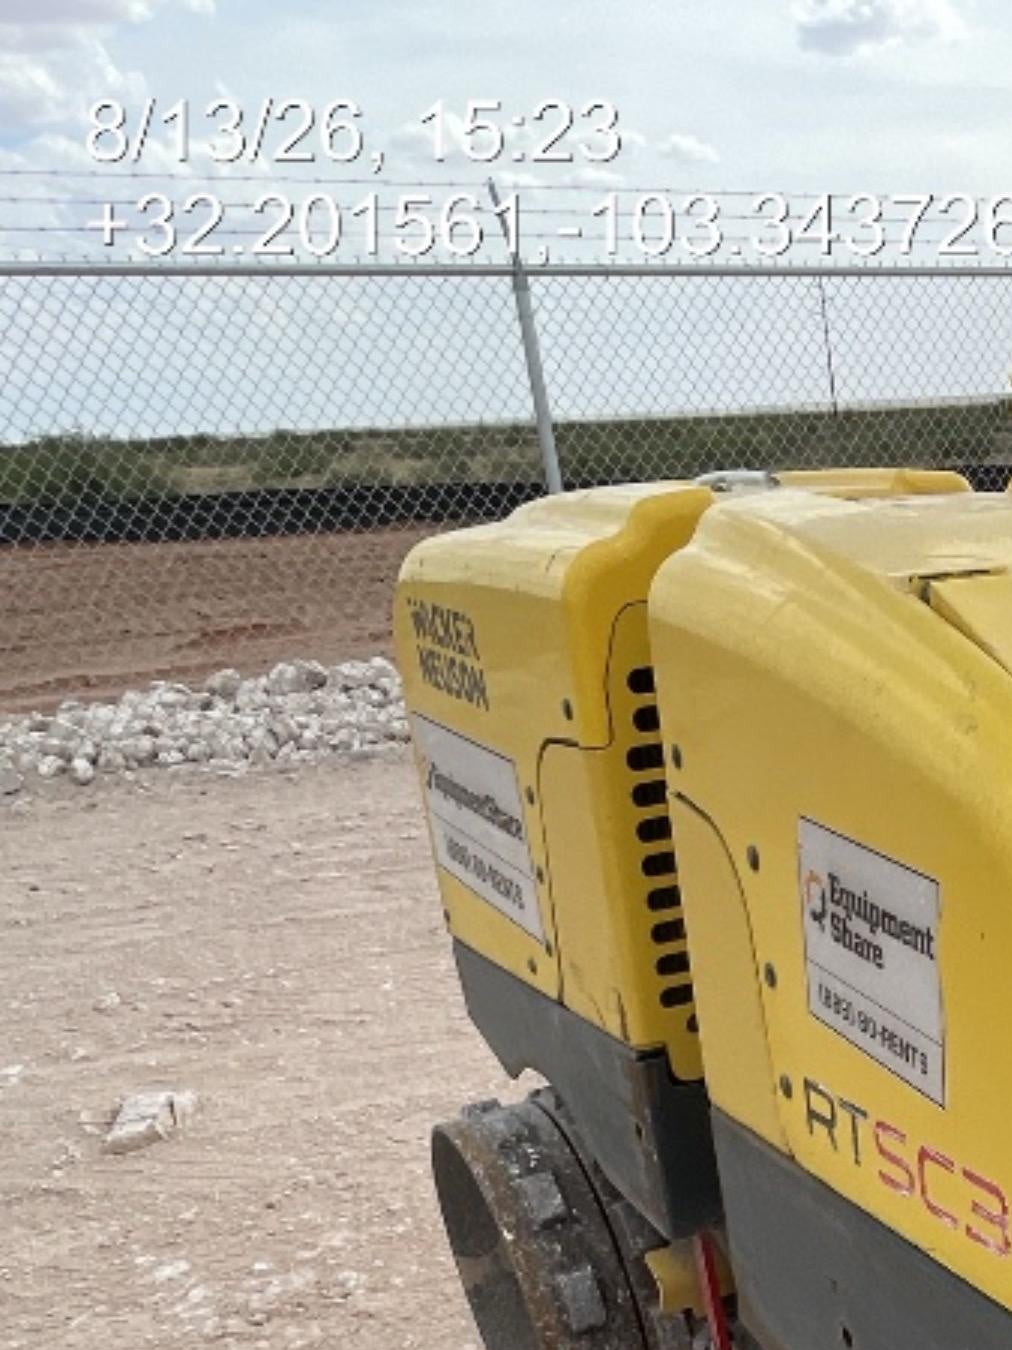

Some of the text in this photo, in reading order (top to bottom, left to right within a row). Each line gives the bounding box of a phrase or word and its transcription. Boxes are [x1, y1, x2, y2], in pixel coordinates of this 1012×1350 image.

[827, 872, 935, 961] Equipment
[829, 912, 885, 970] Share
[803, 1076, 1011, 1256] RTSC3
